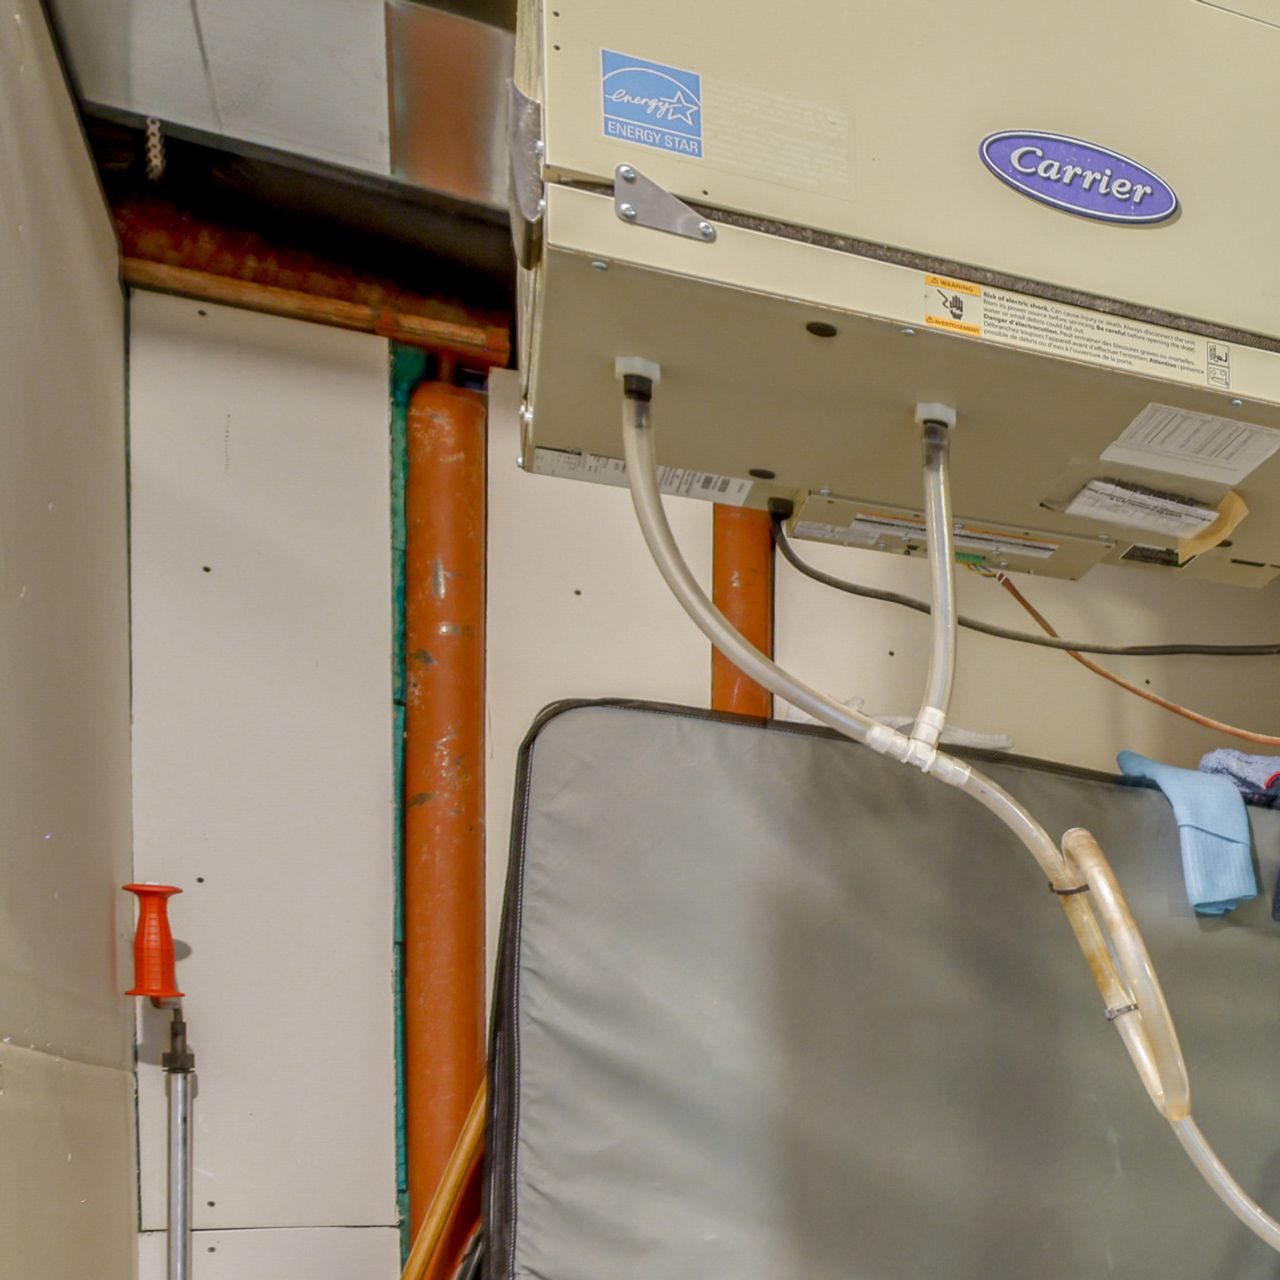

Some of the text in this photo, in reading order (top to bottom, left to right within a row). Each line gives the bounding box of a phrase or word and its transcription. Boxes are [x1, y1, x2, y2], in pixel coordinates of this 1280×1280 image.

[608, 121, 699, 153] ENERGY STAR
[1008, 144, 1153, 206] Carrier
[940, 278, 974, 294] WARNING
[933, 319, 980, 335] AVERTISSEMENT
